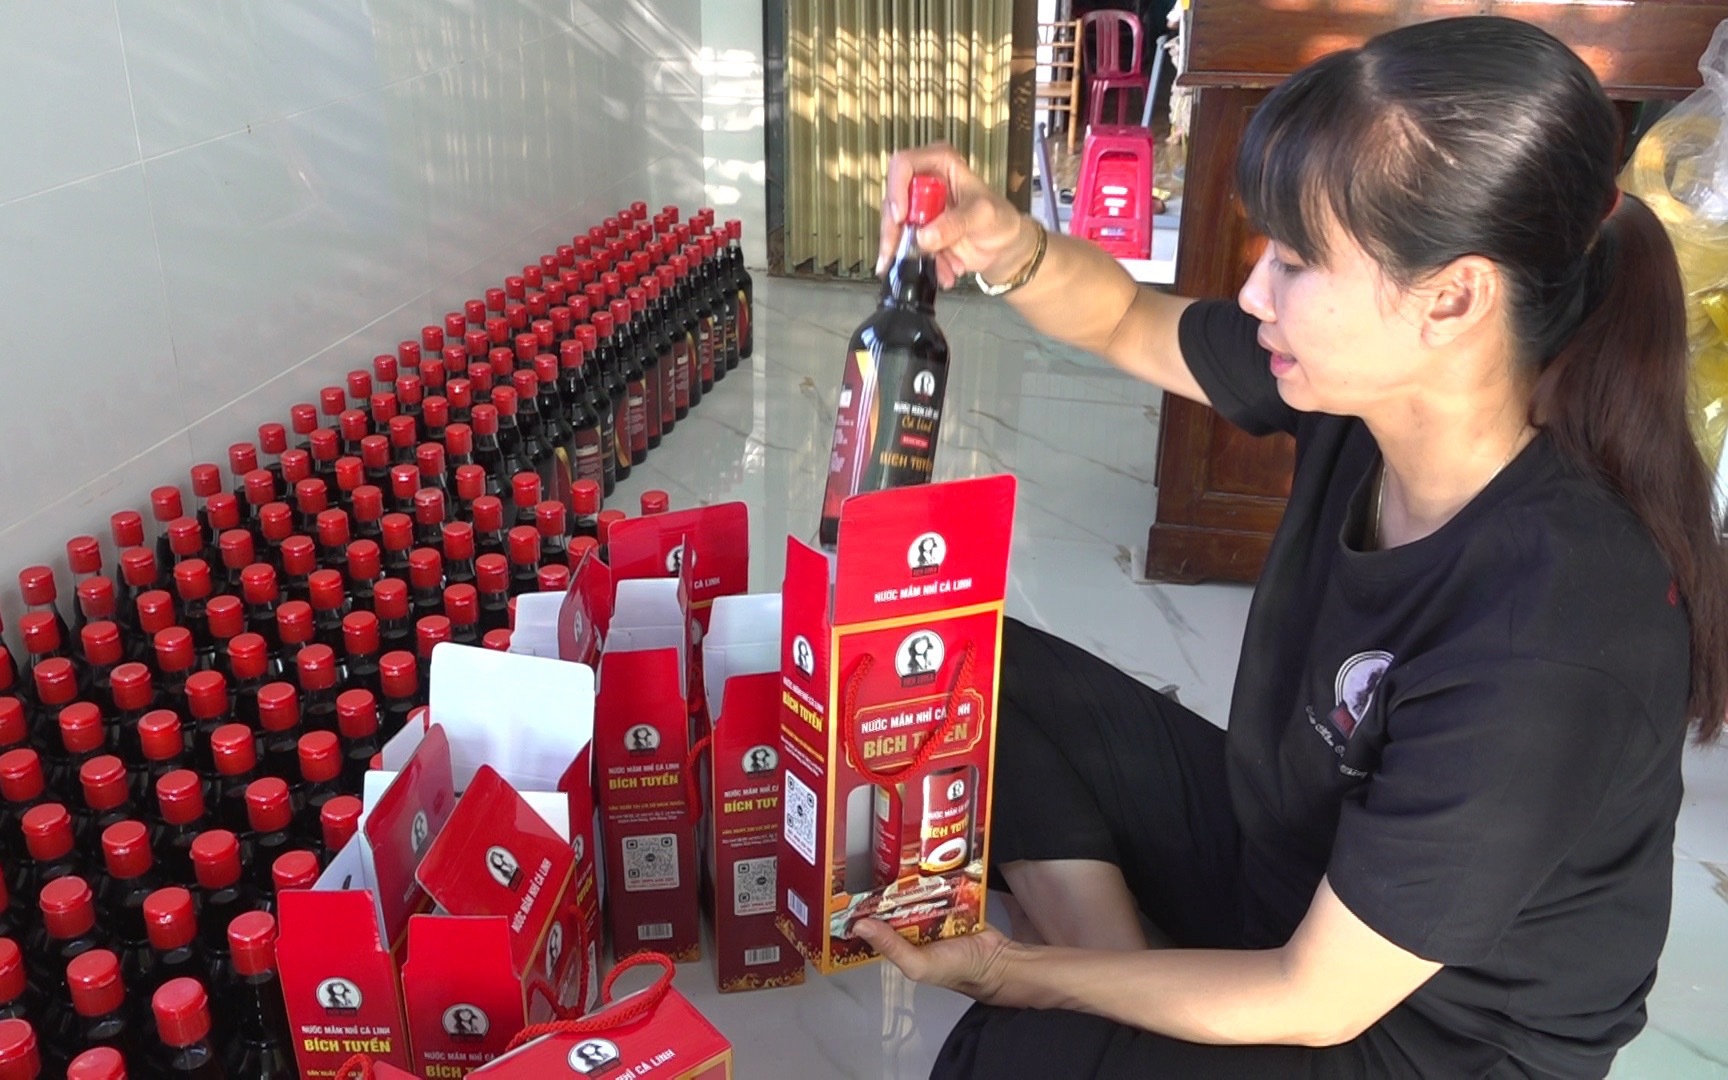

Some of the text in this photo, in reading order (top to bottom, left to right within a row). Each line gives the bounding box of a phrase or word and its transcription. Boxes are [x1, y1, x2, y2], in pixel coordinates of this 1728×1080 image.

[953, 577, 973, 592] LINH
[863, 734, 908, 760] BÍCH
[608, 776, 638, 791] BÍCH
[724, 798, 753, 813] BÍCH
[304, 1037, 340, 1053] BÍCH
[650, 1049, 675, 1067] LINH
[426, 1062, 462, 1079] BÍCH
